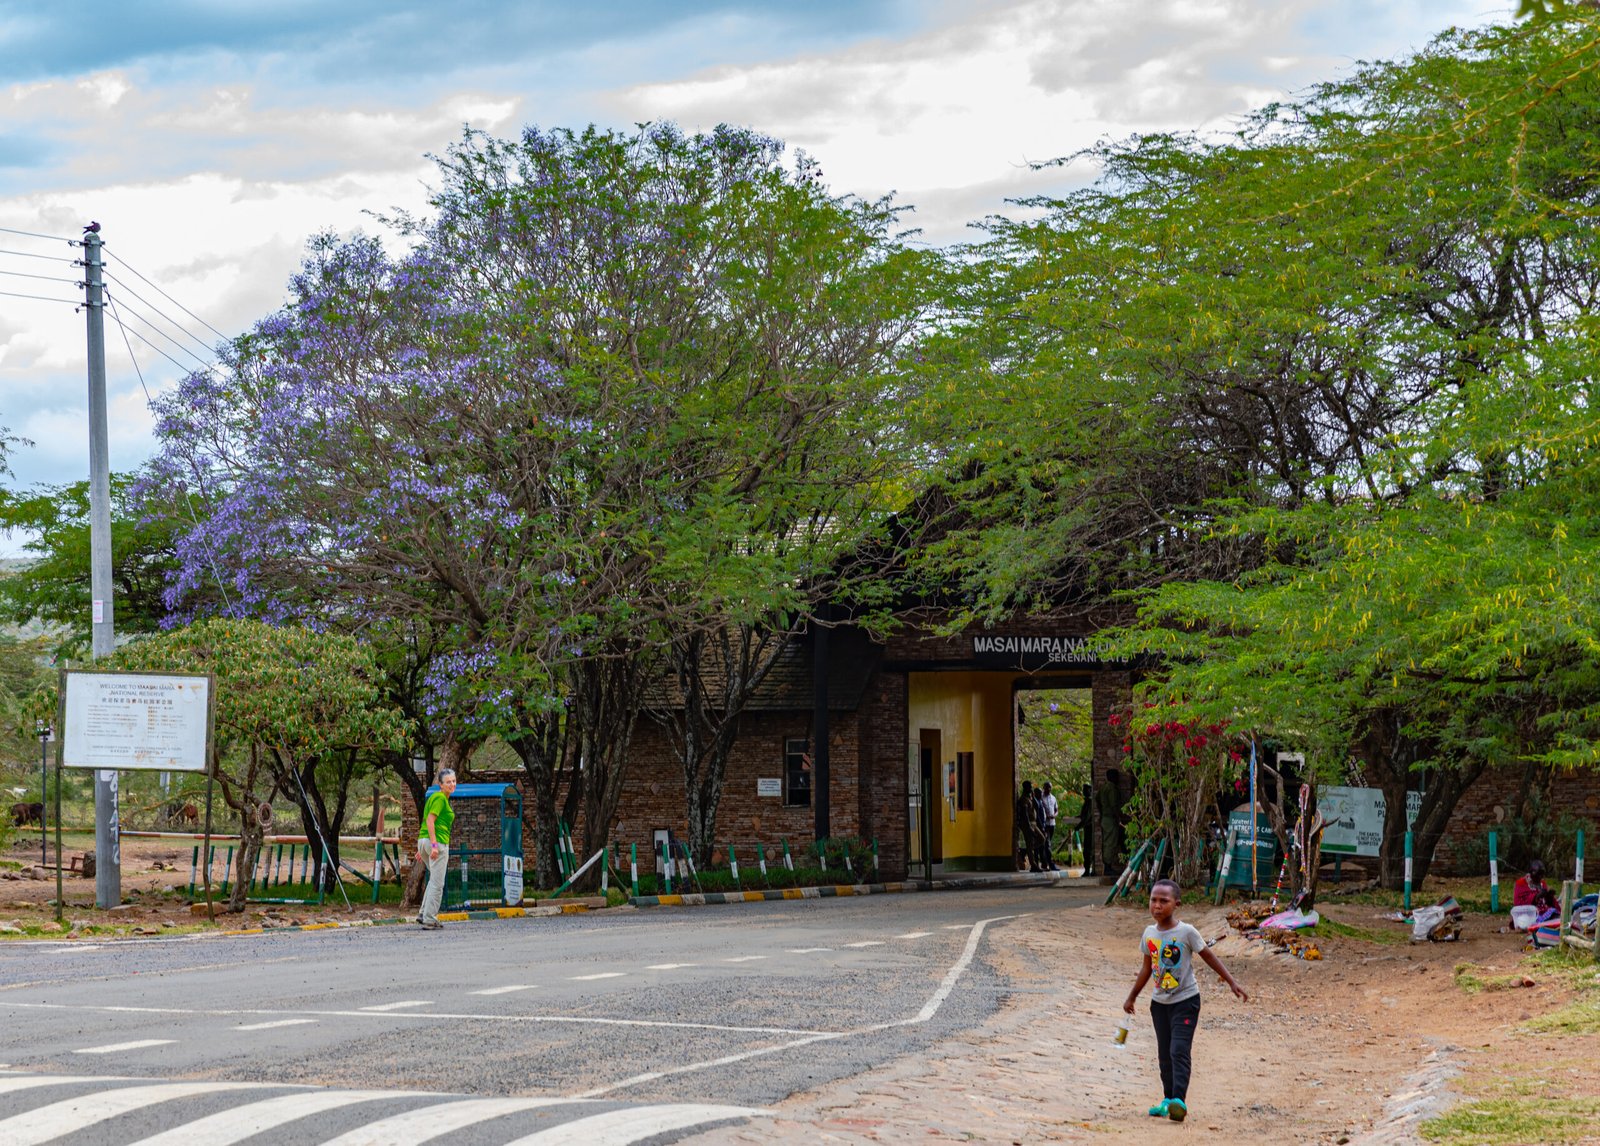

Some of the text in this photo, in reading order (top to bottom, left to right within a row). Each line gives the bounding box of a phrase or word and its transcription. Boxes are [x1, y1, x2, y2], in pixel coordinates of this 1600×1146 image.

[974, 636, 1018, 653] MASAI
[1020, 637, 1061, 653] MARA
[1048, 652, 1097, 663] SEKENANI
